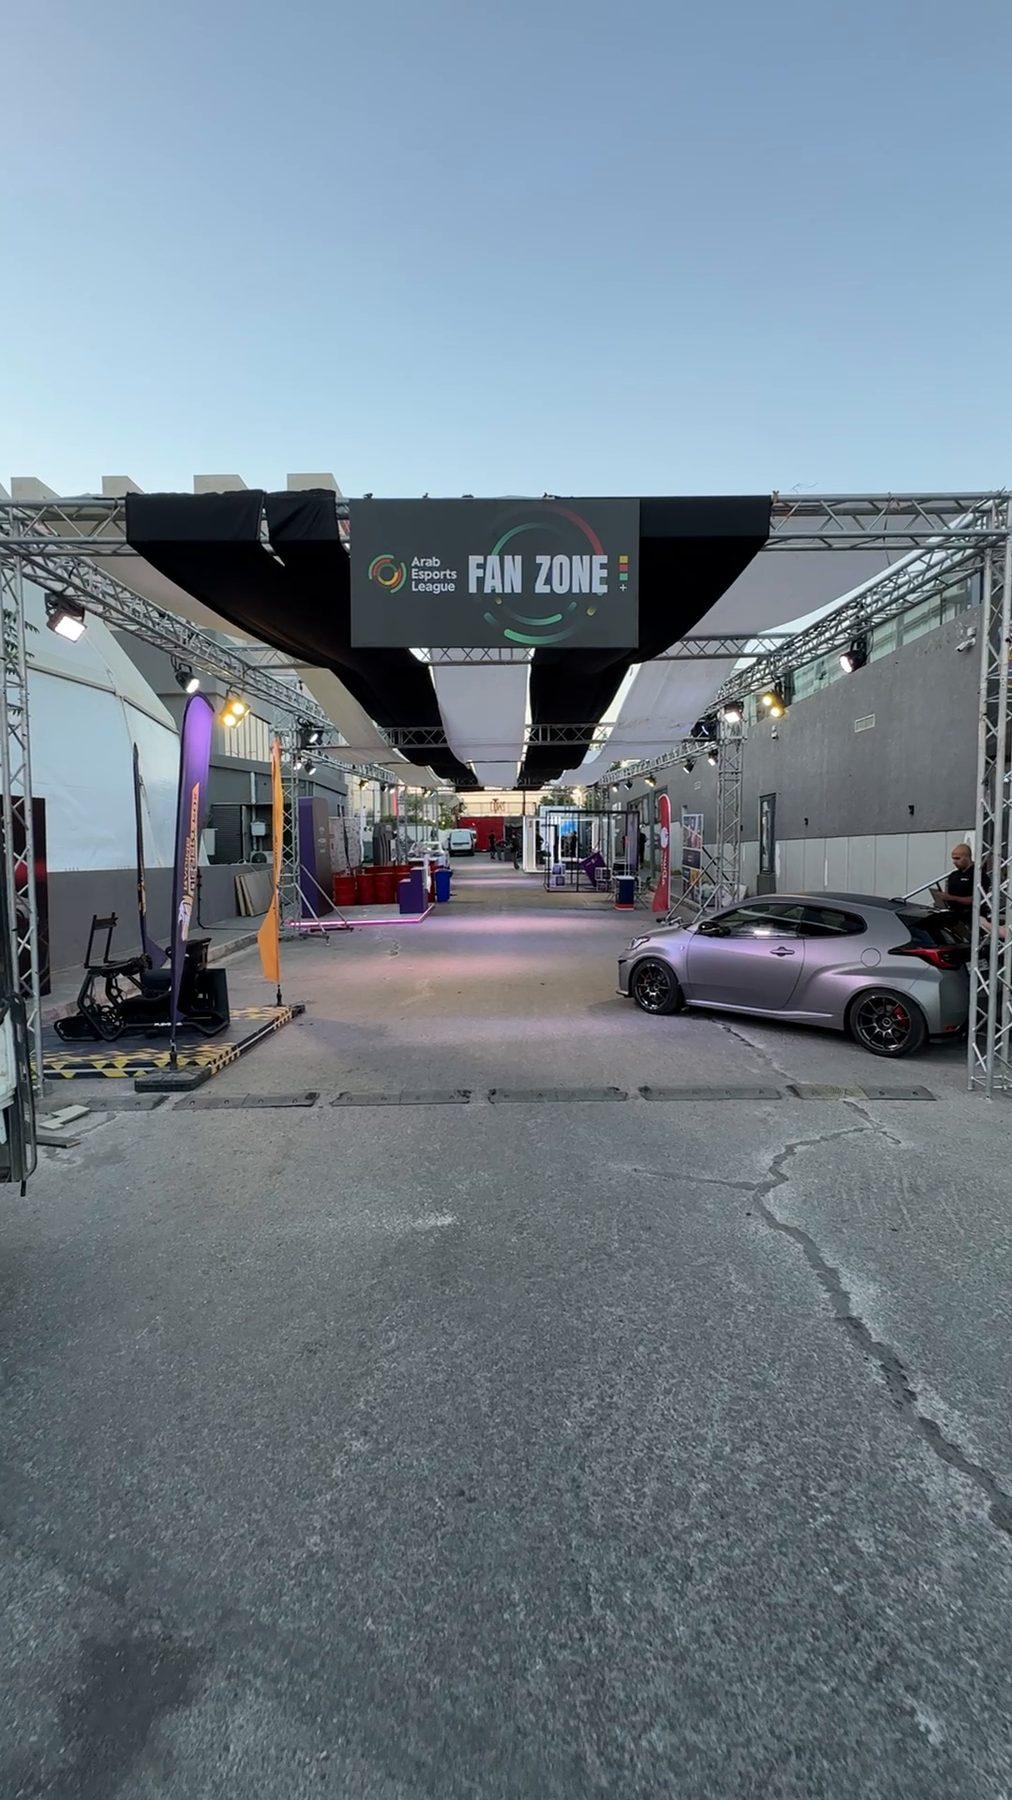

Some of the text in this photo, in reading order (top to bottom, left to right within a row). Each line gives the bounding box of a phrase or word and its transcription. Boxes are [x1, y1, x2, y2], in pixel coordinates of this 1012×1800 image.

[411, 556, 440, 568] Arab
[411, 569, 458, 581] Esports
[468, 554, 608, 594] FAN ZONE
[411, 581, 456, 593] League
